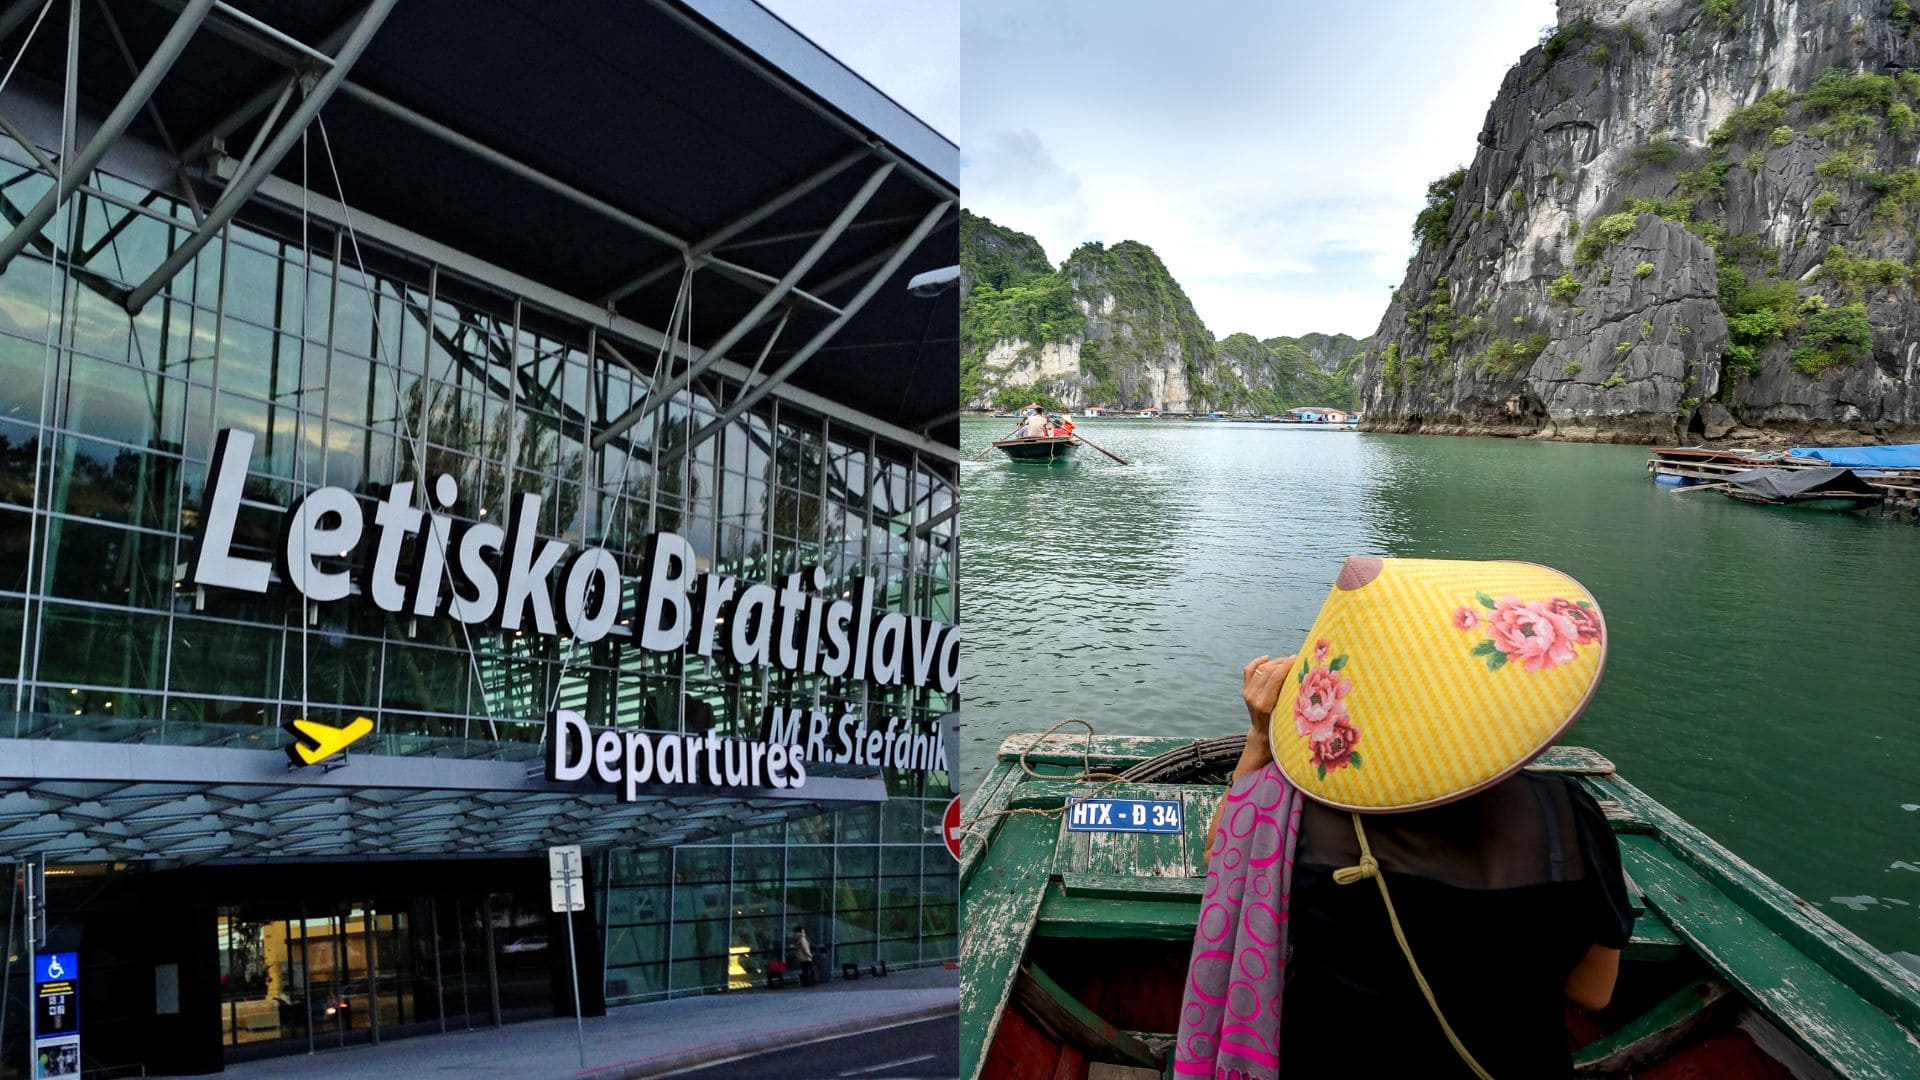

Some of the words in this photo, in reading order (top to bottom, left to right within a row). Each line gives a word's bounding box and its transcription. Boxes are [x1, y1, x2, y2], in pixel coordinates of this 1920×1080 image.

[195, 428, 621, 642] Letisko
[555, 709, 807, 801] Departures
[1073, 803, 1112, 825] HTX
[1152, 805, 1178, 827] 34
